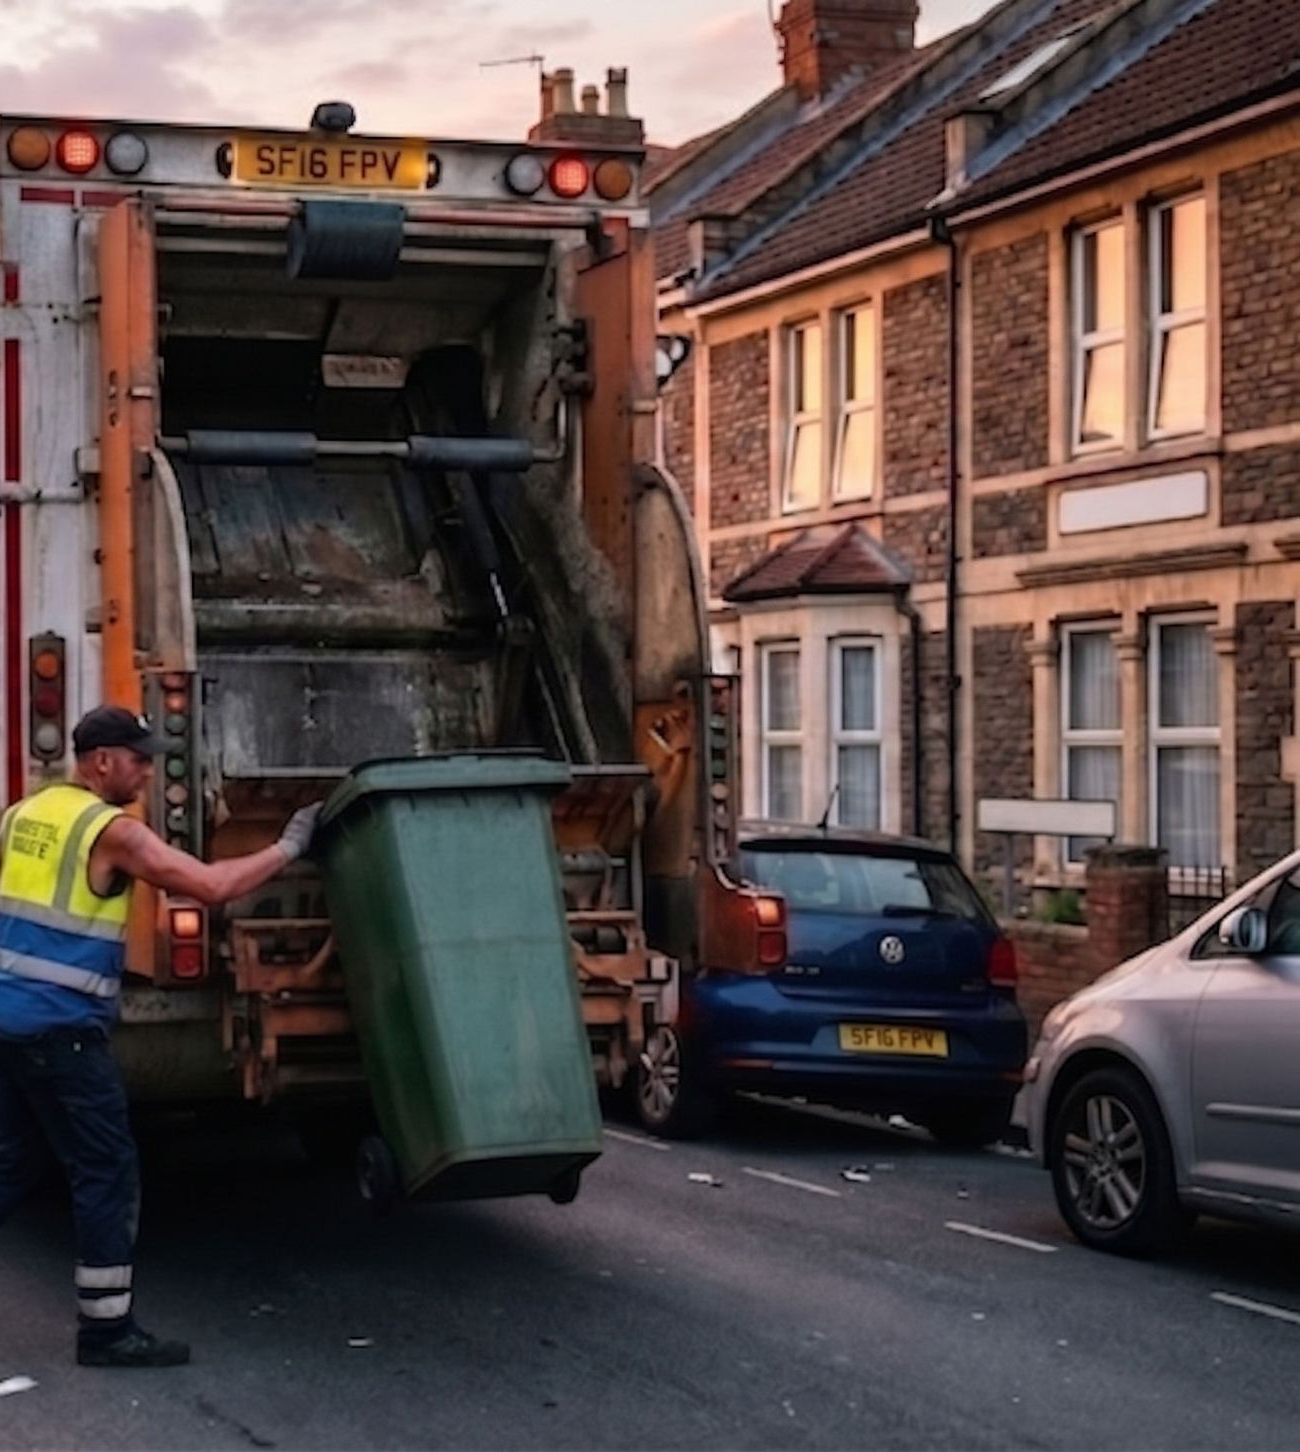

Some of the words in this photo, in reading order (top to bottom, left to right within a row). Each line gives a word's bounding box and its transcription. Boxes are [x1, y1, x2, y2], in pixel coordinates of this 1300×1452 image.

[256, 144, 327, 179] SF16
[339, 149, 402, 181] FPV
[851, 1026, 894, 1047] SF16
[897, 1028, 935, 1050] FPV
